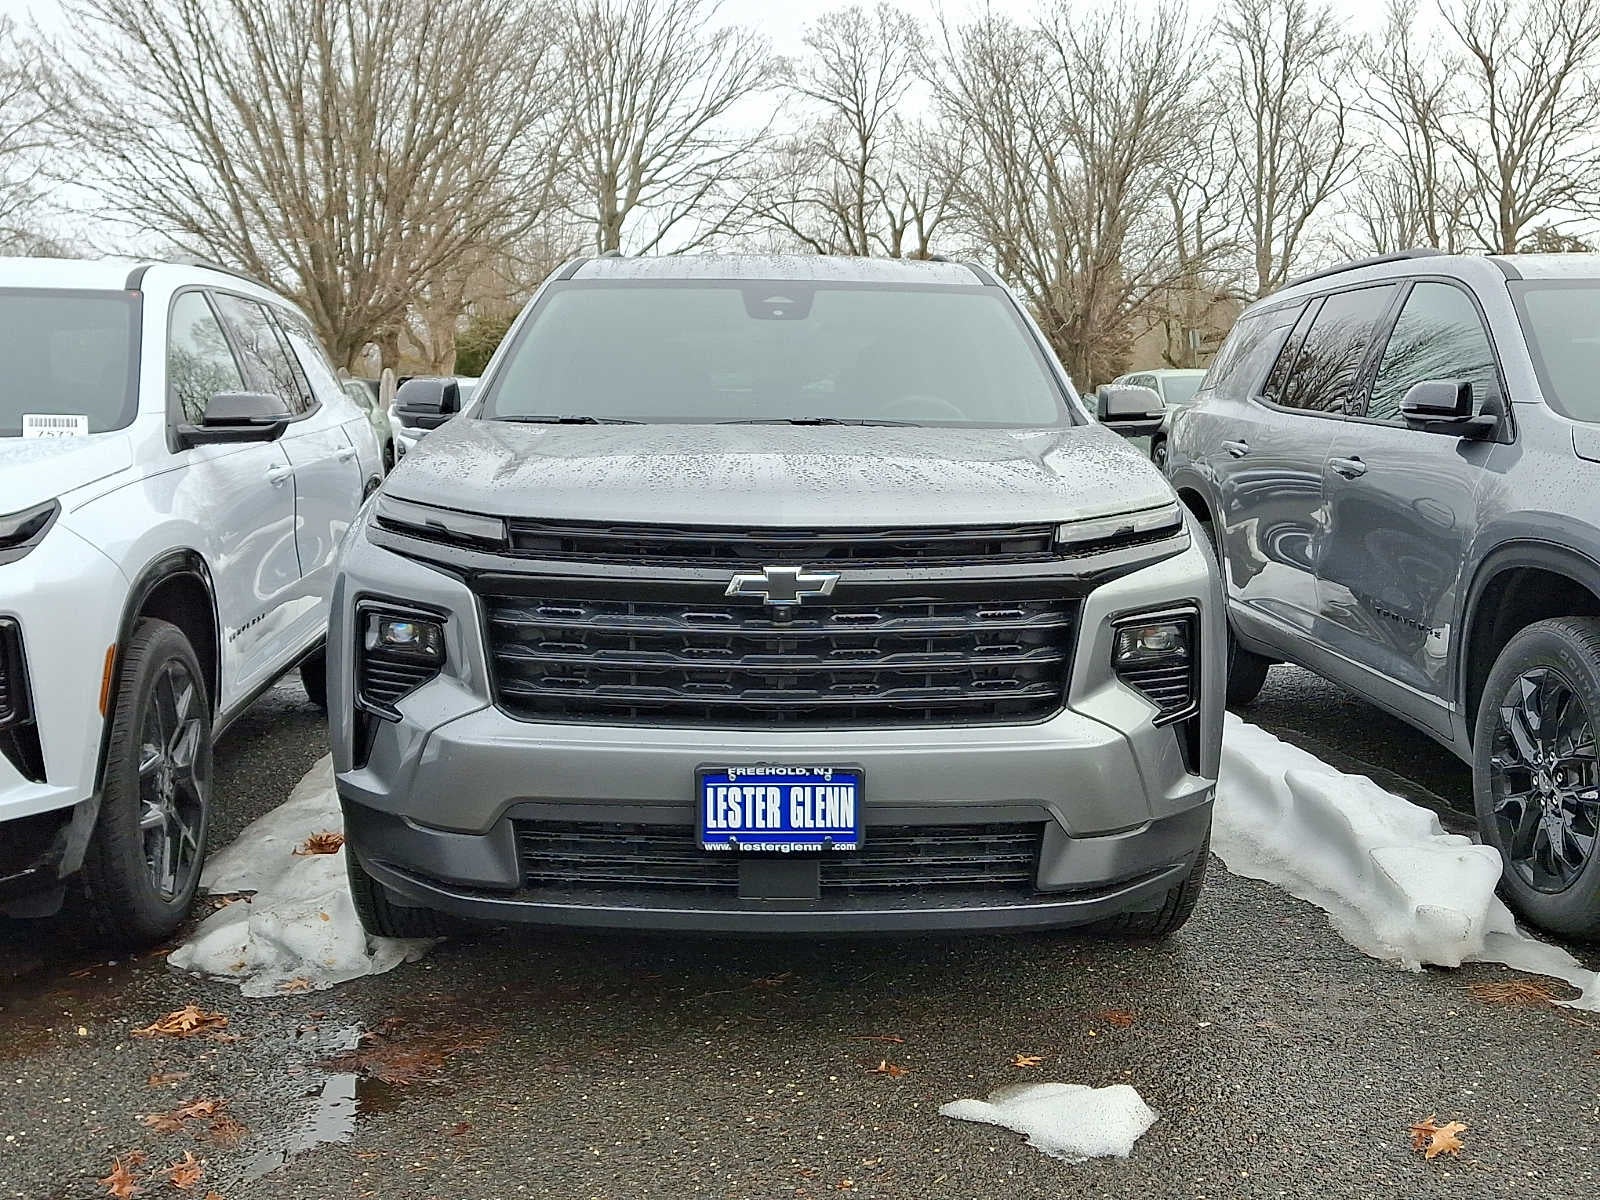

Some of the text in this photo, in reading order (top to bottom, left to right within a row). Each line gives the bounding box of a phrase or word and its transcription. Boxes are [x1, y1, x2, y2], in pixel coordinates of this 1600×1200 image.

[814, 767, 833, 776] NJ
[706, 786, 855, 829] LESTER GLENN
